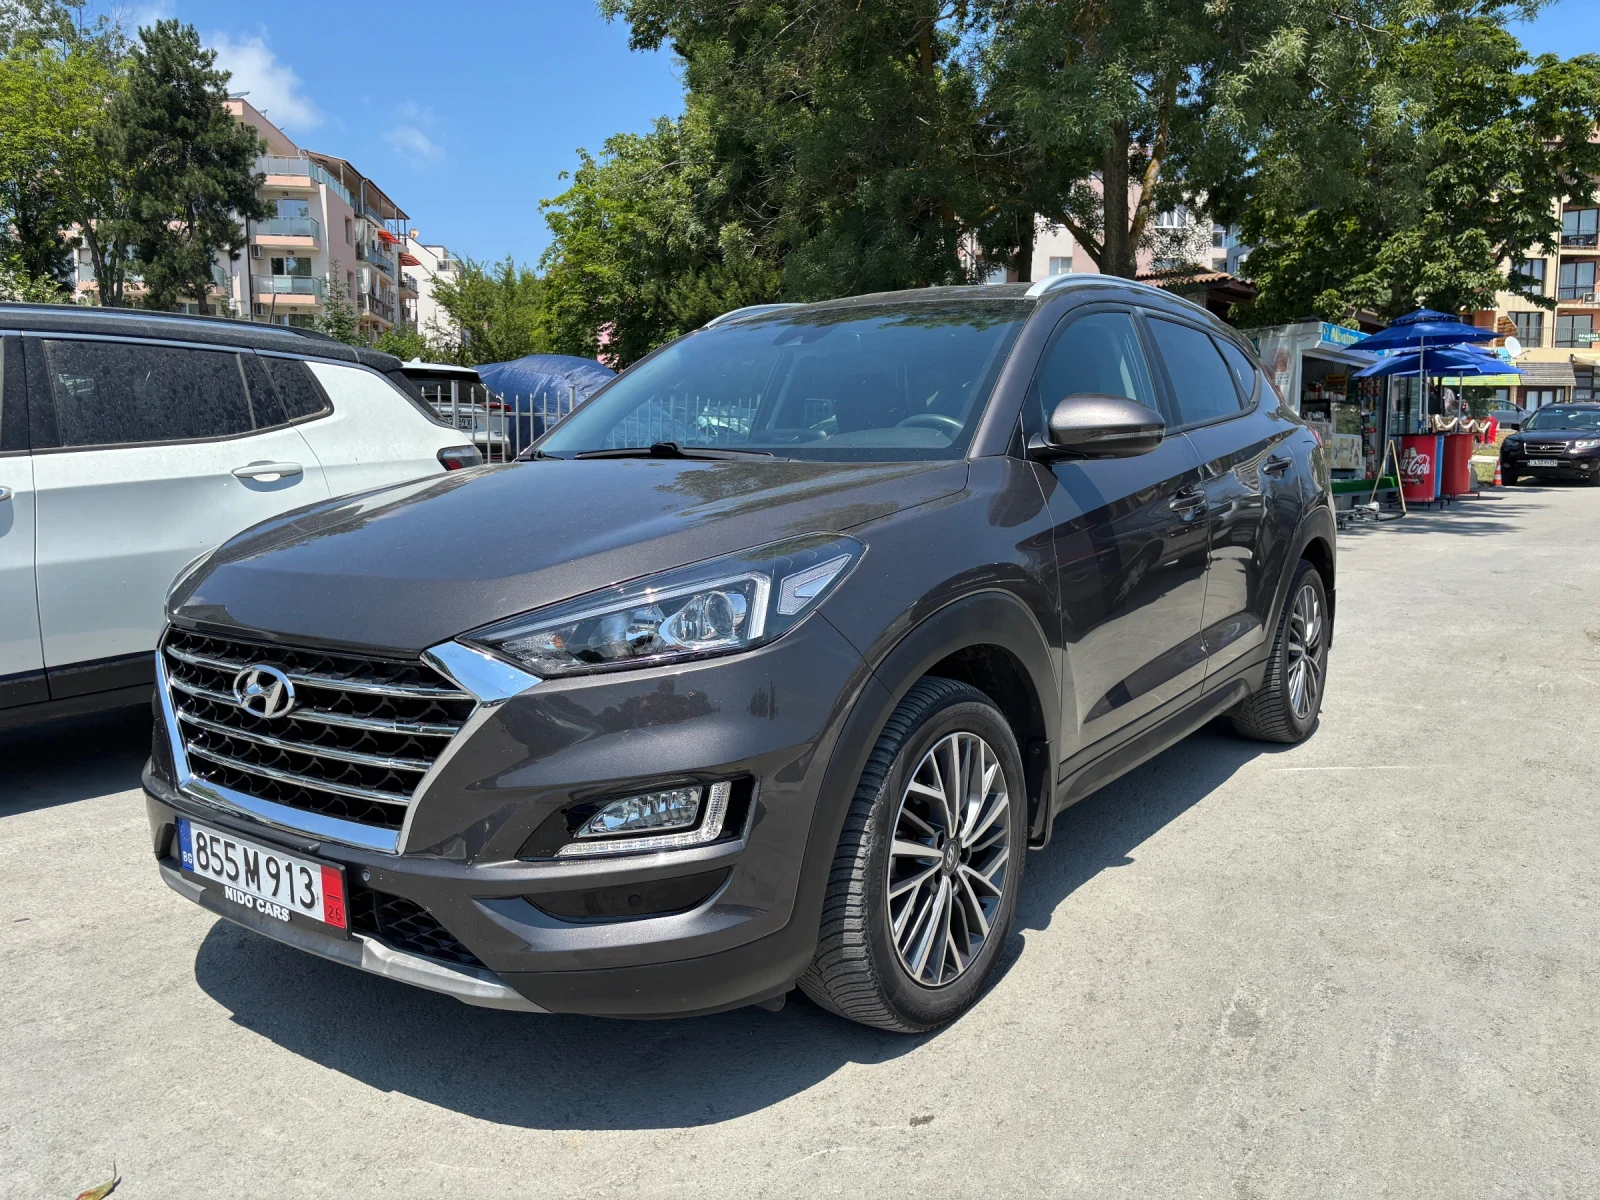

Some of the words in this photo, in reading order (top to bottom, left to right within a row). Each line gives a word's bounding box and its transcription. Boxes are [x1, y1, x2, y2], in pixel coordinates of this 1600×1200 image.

[182, 850, 193, 864] BG
[327, 903, 342, 922] 26
[224, 885, 254, 908] NIDO
[256, 898, 291, 923] CARS
